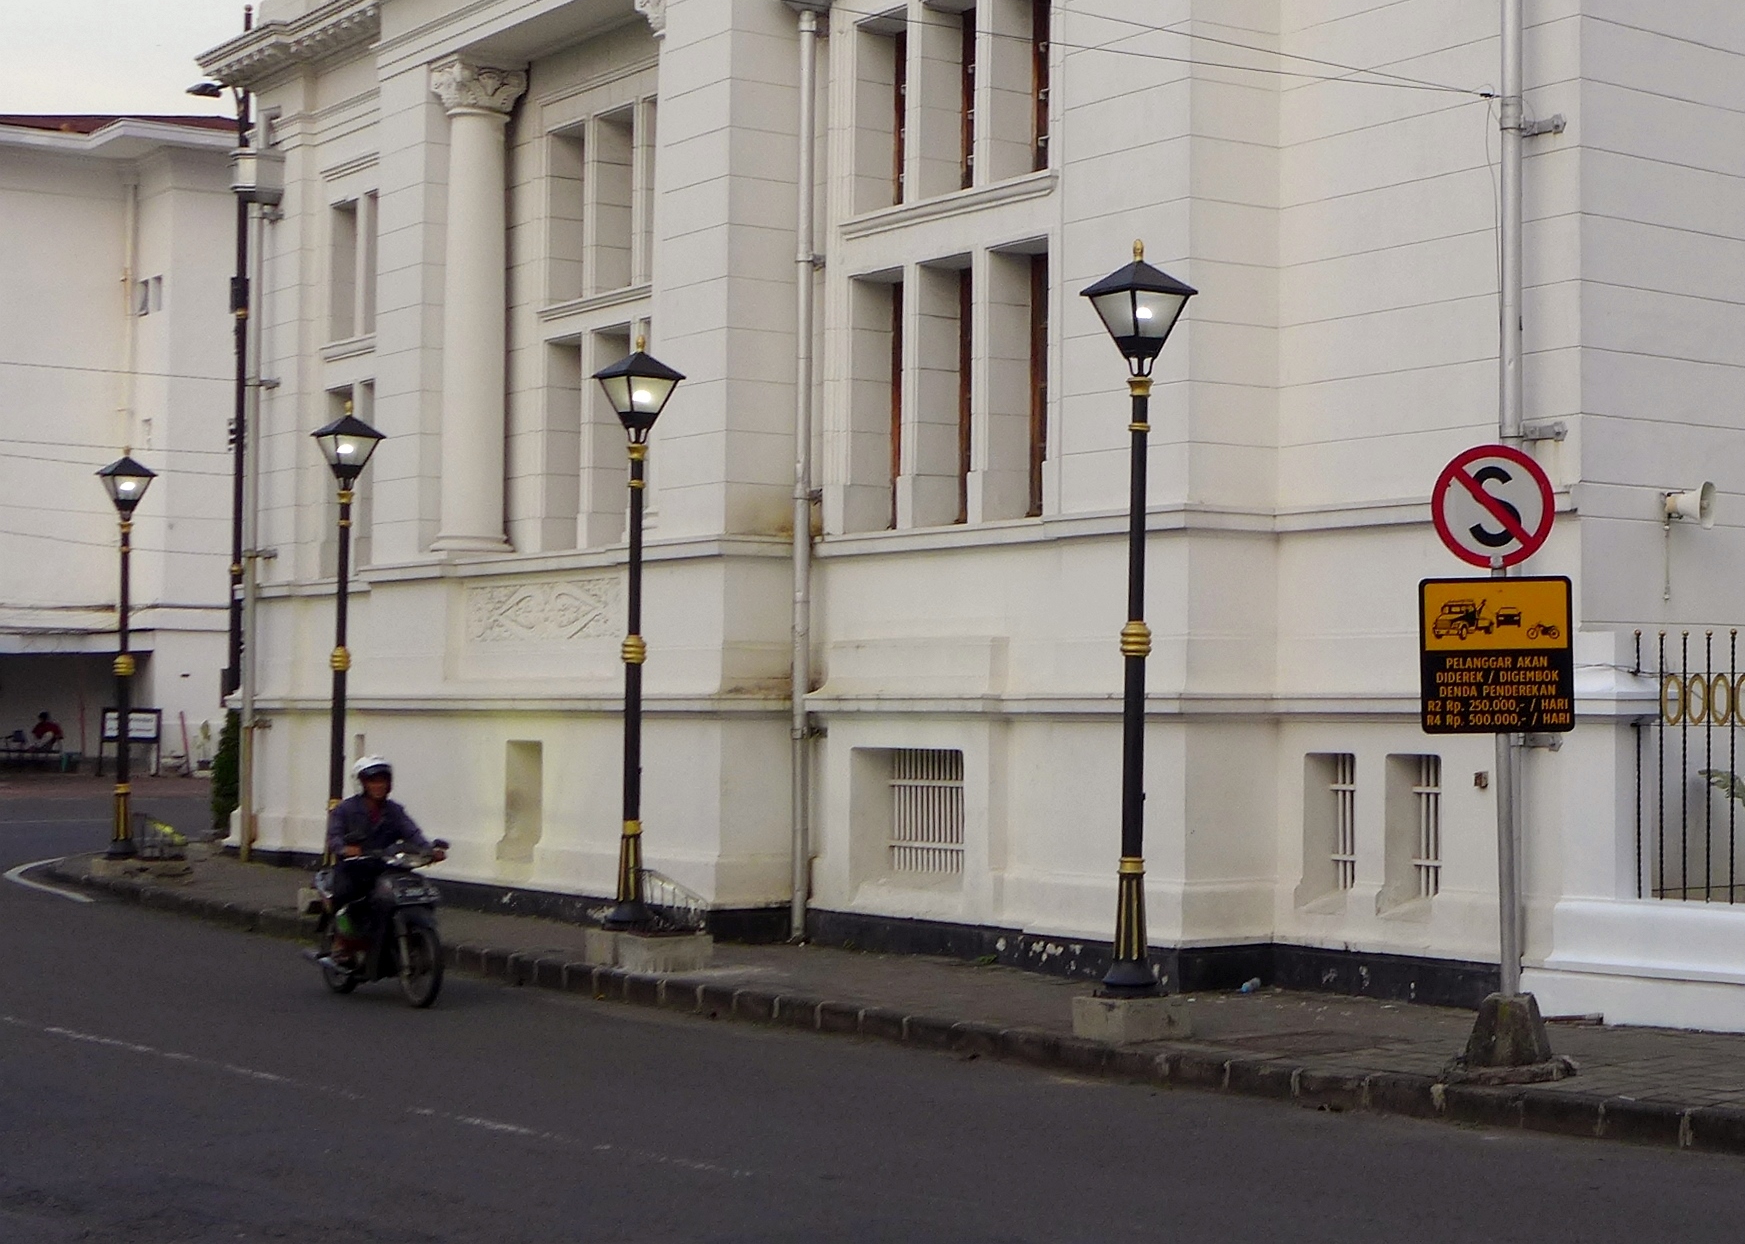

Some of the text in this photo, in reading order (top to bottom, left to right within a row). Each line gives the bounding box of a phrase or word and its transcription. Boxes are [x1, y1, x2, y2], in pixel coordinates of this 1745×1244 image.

[1446, 656, 1548, 669] PELANGGAR AKAN
[1436, 671, 1484, 683] DIDEREK
[1499, 670, 1559, 682] DIGEMBOK
[1439, 685, 1556, 697] DENDA PENDEREKAN
[1427, 700, 1442, 711] R2
[1446, 700, 1465, 714] Rp.
[1541, 698, 1568, 710] HARI
[1427, 714, 1441, 726] R4
[1446, 714, 1465, 728] Rp.
[1543, 713, 1570, 724] HARI
